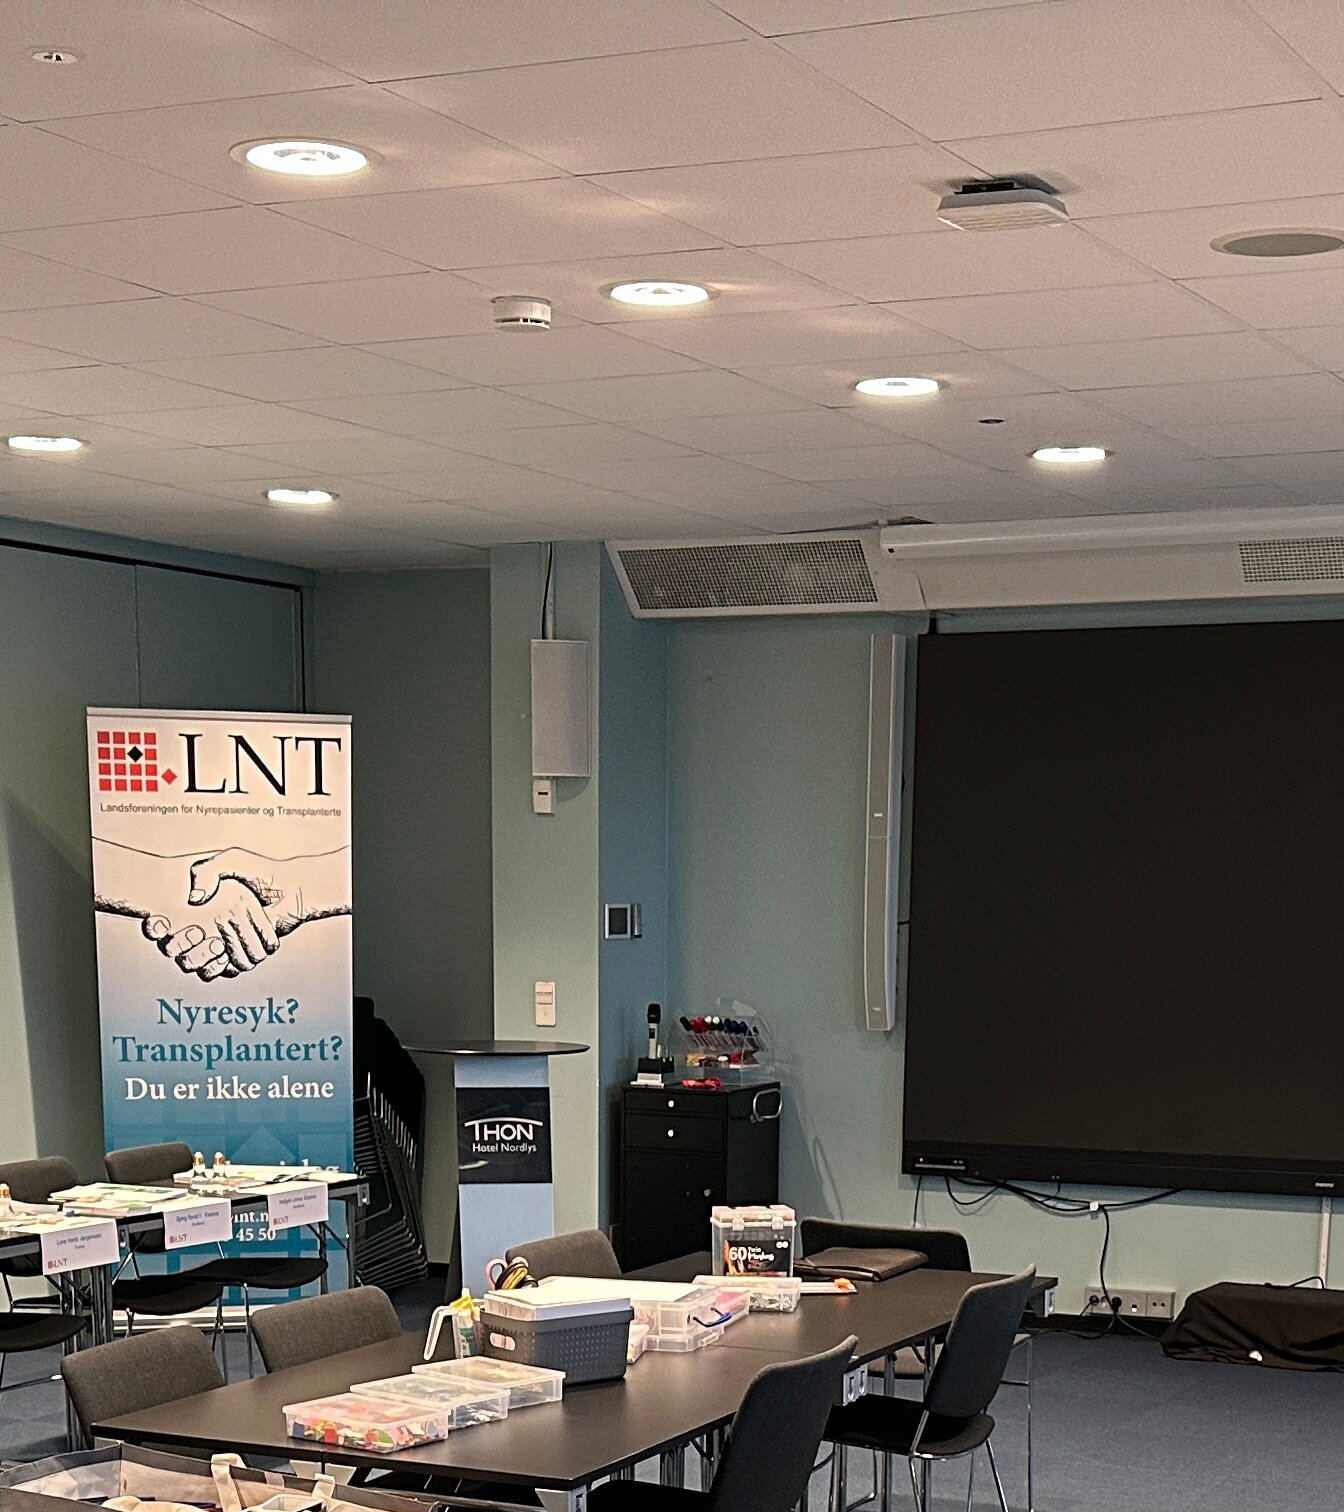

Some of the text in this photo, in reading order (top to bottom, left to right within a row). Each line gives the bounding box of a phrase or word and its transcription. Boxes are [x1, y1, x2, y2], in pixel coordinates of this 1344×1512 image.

[179, 733, 342, 796] LNT
[100, 803, 342, 817] Landsforeningen for Nyrepasienter og Transplanterte
[157, 997, 299, 1033] Nyresyk?
[112, 1034, 343, 1070] Transplantert?
[125, 1075, 334, 1100] Du er ikke alene
[465, 1117, 543, 1141] THON
[472, 1143, 537, 1154] Hotel Nordlys
[235, 1228, 276, 1242] 45 50
[729, 1246, 748, 1261] 60
